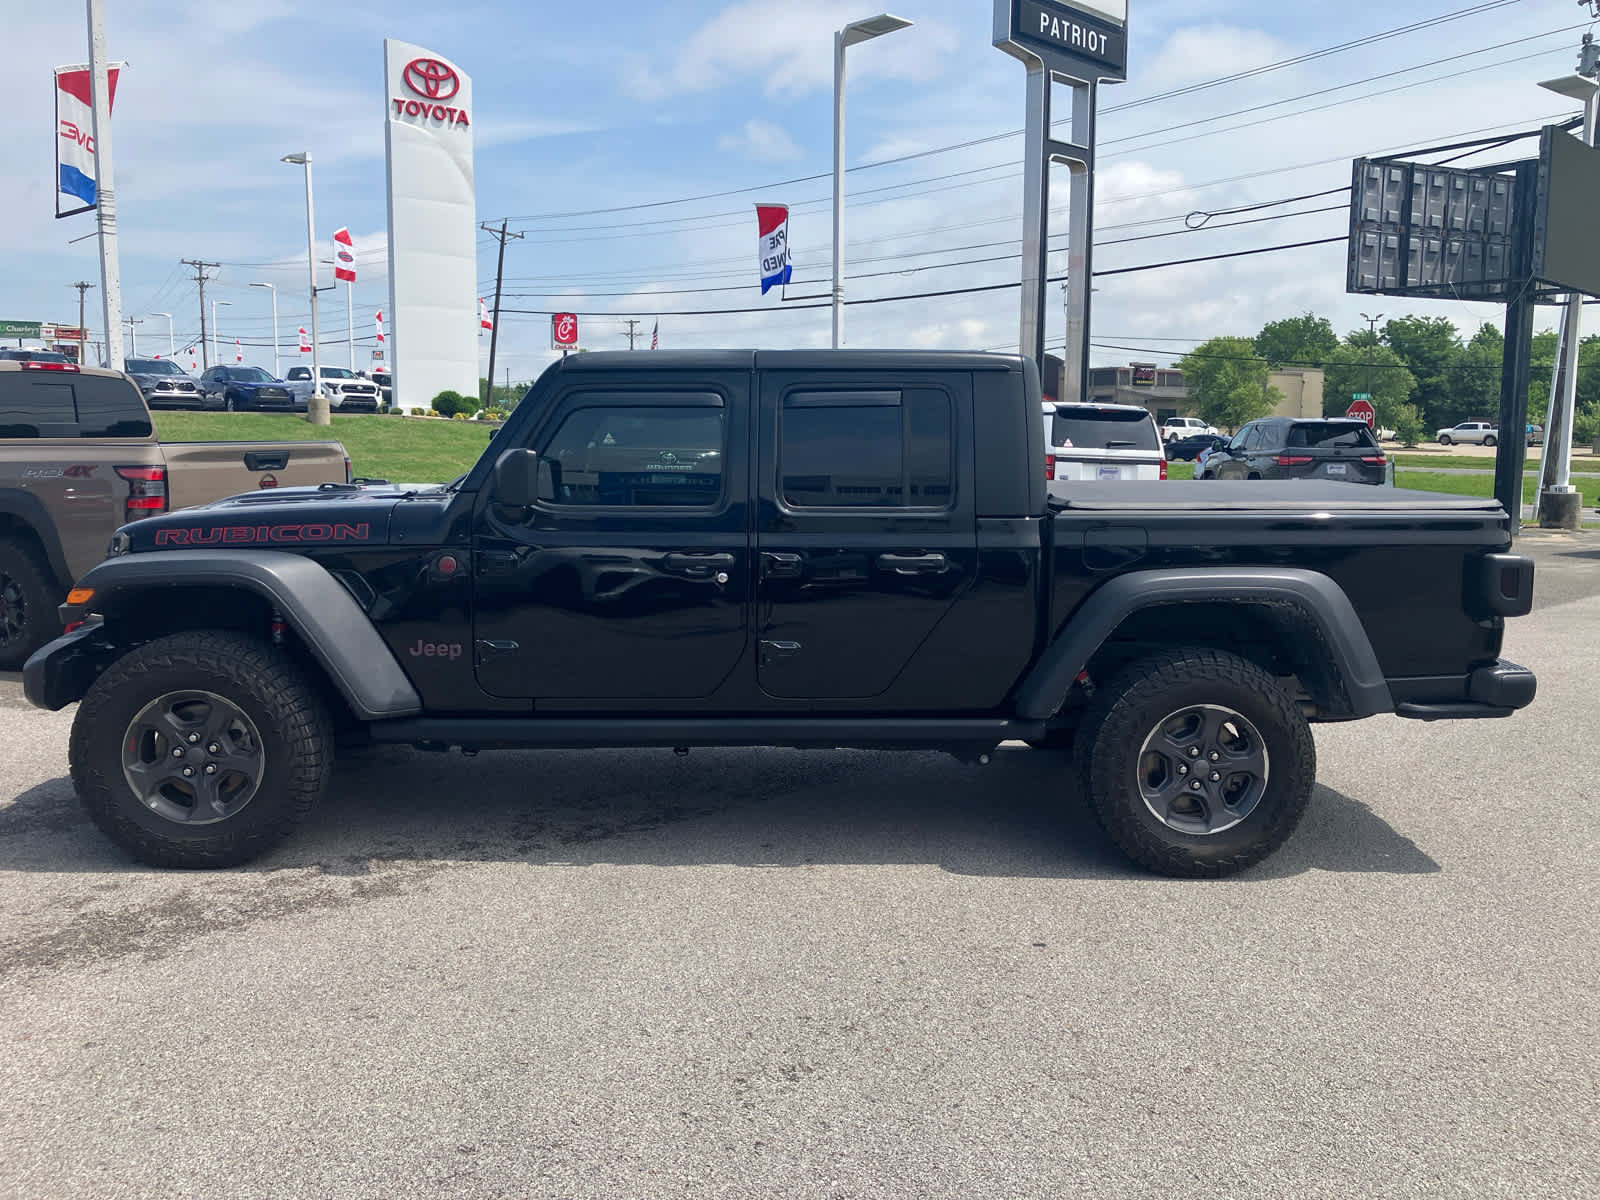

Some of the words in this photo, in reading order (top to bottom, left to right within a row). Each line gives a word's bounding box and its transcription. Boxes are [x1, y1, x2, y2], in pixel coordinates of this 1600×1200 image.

[1040, 12, 1107, 55] PATRIOT
[393, 98, 469, 126] TOYOTA
[155, 523, 369, 545] RUBICON
[409, 640, 462, 661] Jeep
